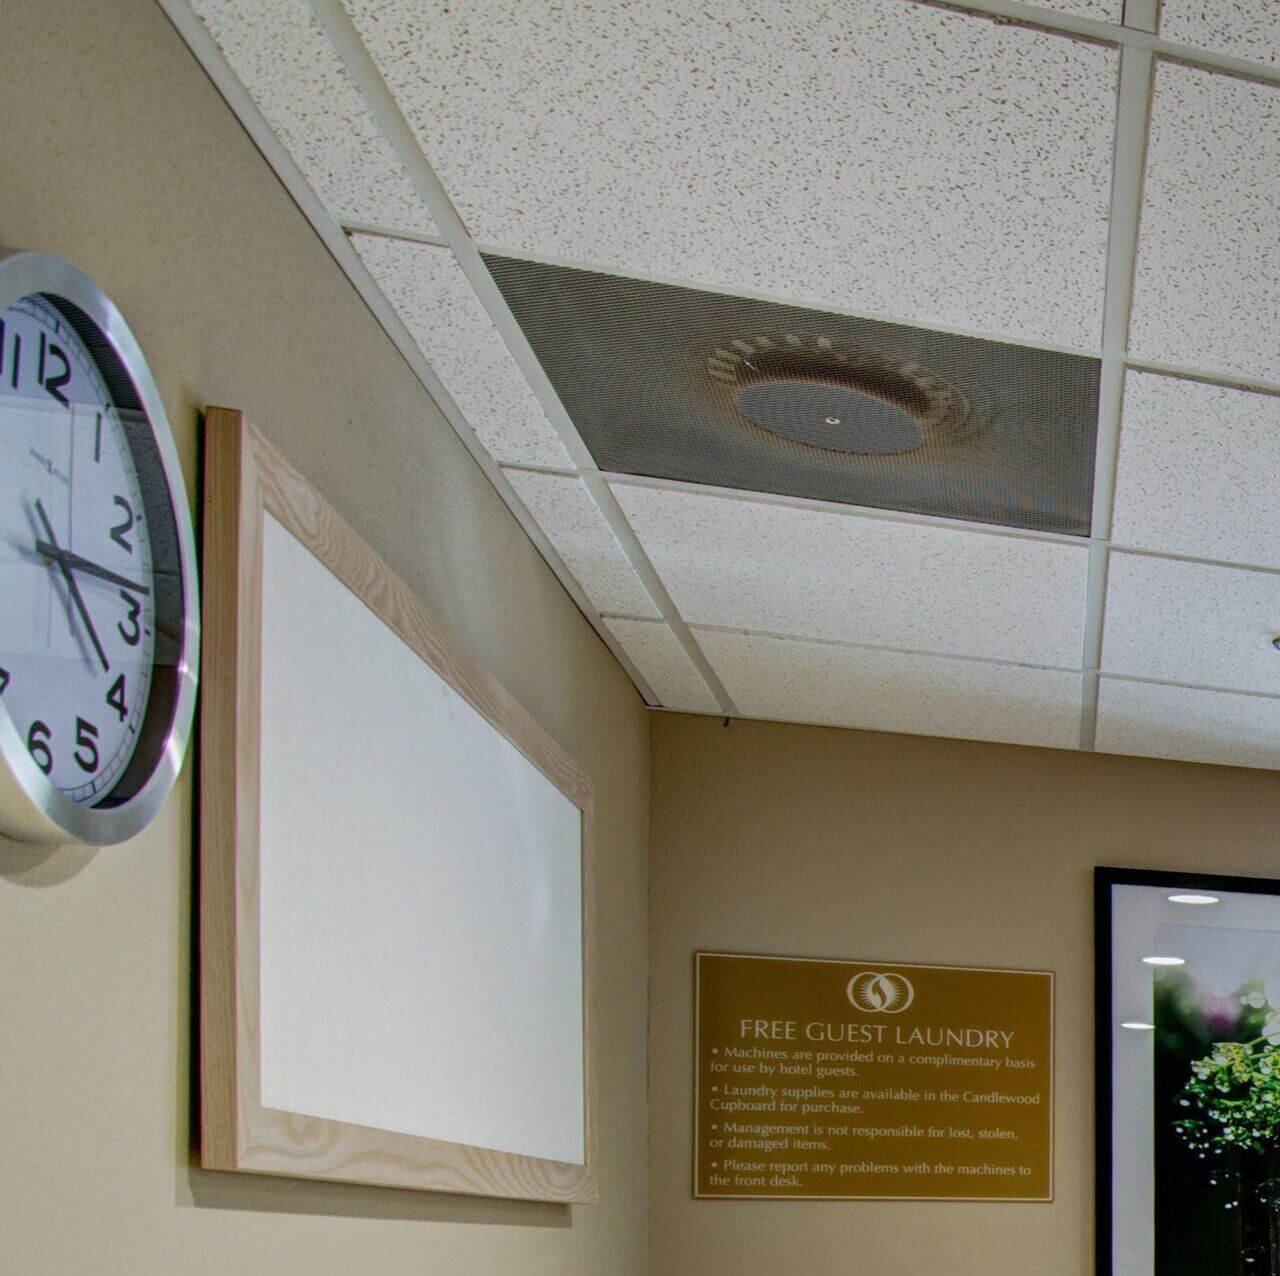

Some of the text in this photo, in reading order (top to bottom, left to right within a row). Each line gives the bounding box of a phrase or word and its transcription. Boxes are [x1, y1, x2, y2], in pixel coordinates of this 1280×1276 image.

[39, 332, 71, 410] 12
[95, 411, 102, 462] 1
[110, 495, 134, 554] 2
[118, 589, 141, 647] 3
[106, 673, 129, 722] 4
[28, 720, 53, 776] 6
[73, 715, 99, 773] 5
[740, 1019, 1015, 1048] FREE GUEST LAUNDRY
[710, 1060, 860, 1079] for use by hotel guests.
[724, 1047, 1036, 1070] Machines are provided on a complimentary basis
[710, 1099, 864, 1115] Cupboard for purchase.
[724, 1084, 1040, 1104] Laundry supplies are available in the Candlewood
[709, 1137, 831, 1152] or damaged items.
[724, 1122, 809, 1137] Management
[813, 1124, 824, 1135] is
[828, 1125, 848, 1136] not
[852, 1125, 925, 1139] responsible
[928, 1126, 945, 1138] for
[978, 1127, 1018, 1141] stolen,
[709, 1174, 803, 1187] the front desk.
[724, 1159, 1032, 1176] Please report any problems with the machines to
